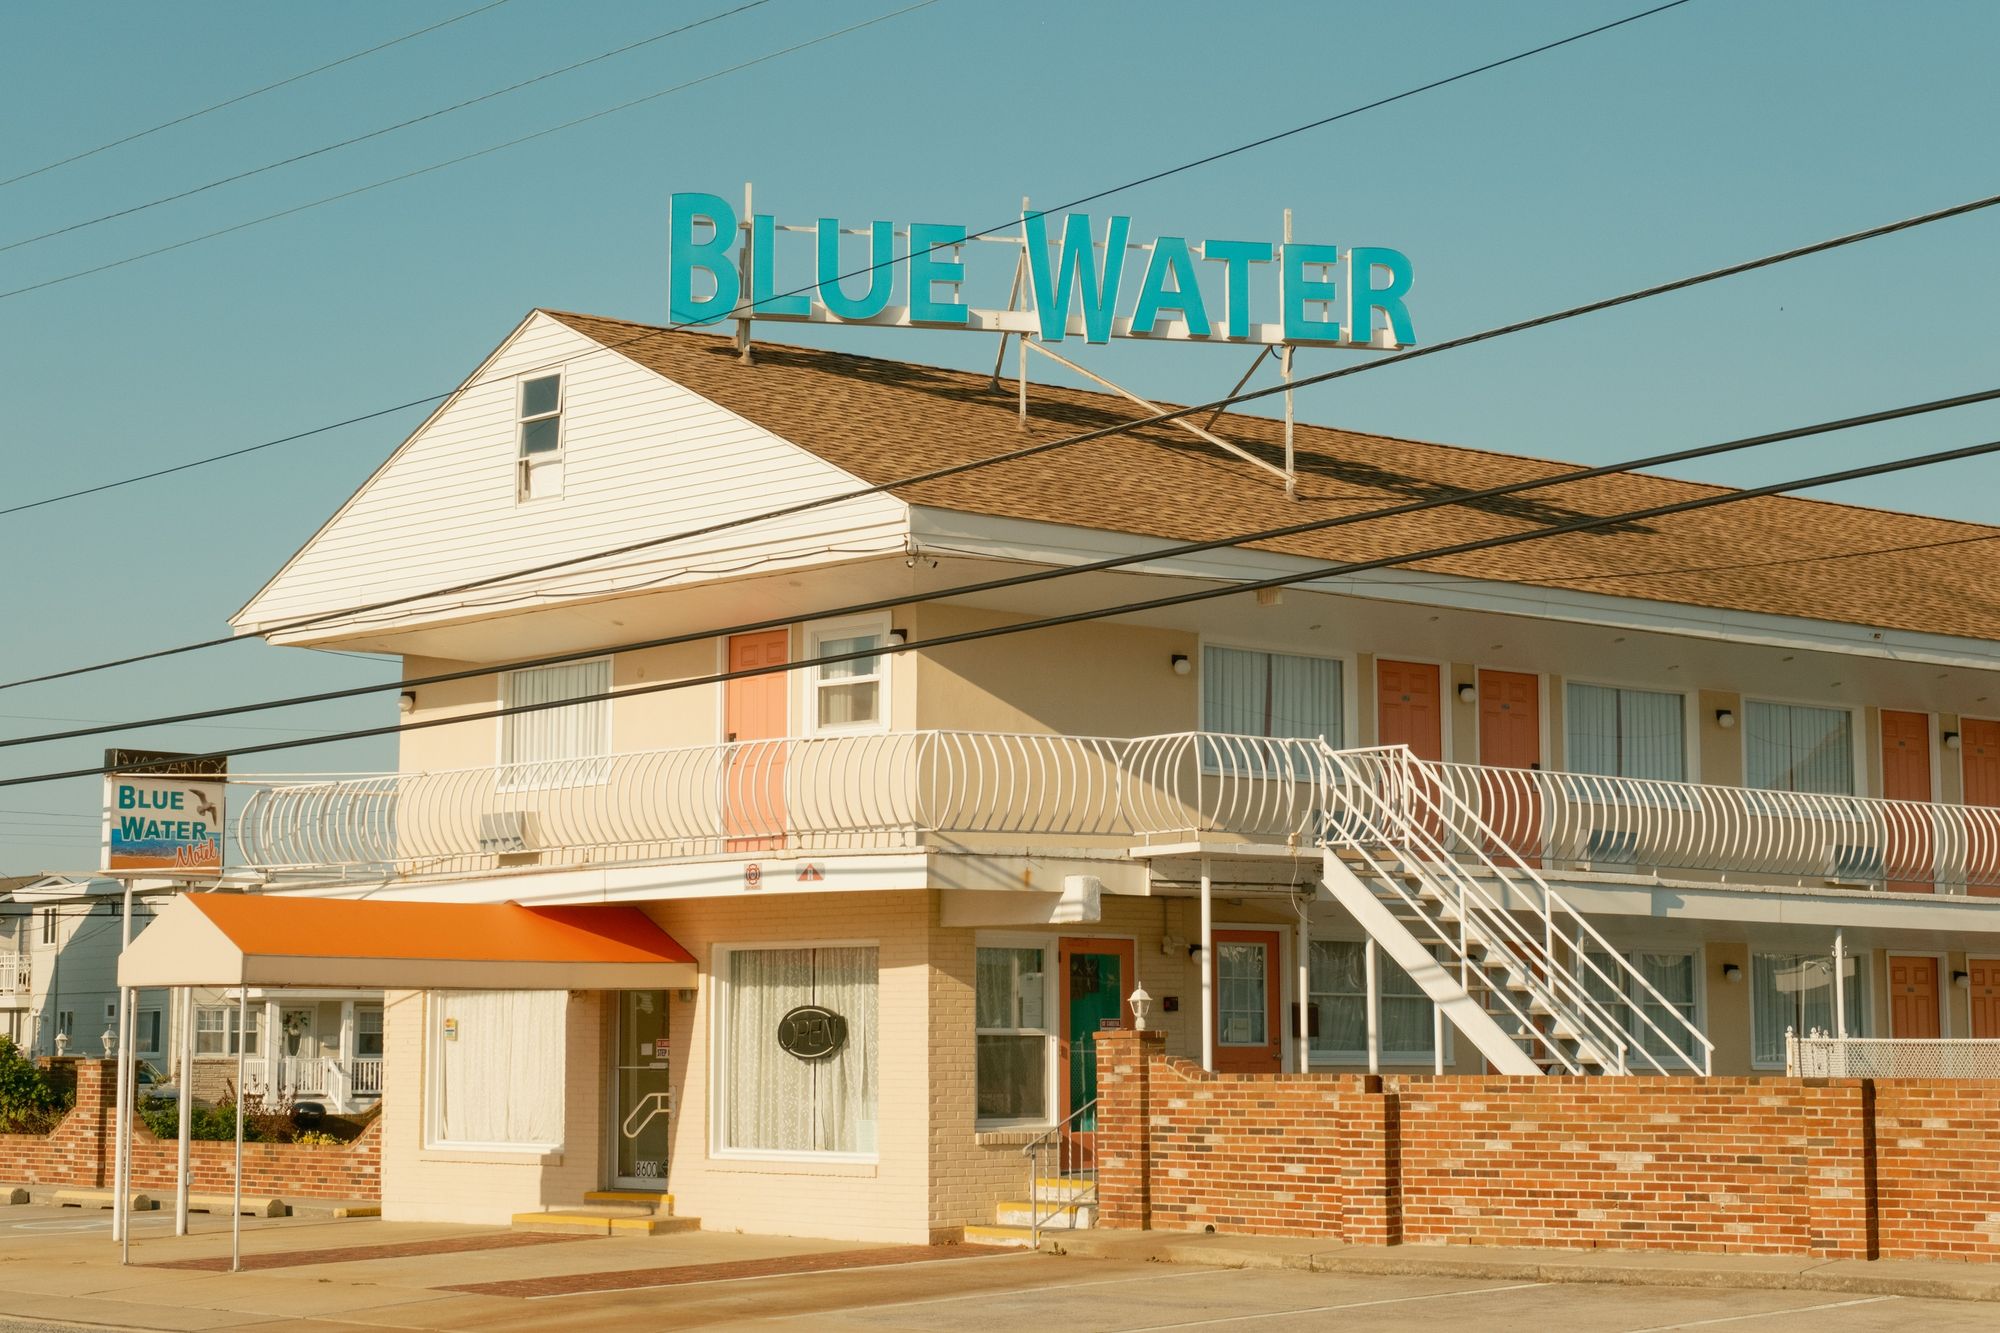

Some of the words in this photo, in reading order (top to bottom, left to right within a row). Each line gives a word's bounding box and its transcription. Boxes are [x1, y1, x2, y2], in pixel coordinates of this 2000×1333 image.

[670, 192, 969, 326] BLUE
[1022, 210, 1417, 347] WATER
[119, 785, 184, 810] BLUE
[120, 816, 206, 840] WATER
[176, 839, 217, 867] Motel
[781, 1018, 837, 1048] OPEN
[636, 1162, 657, 1176] 8600
